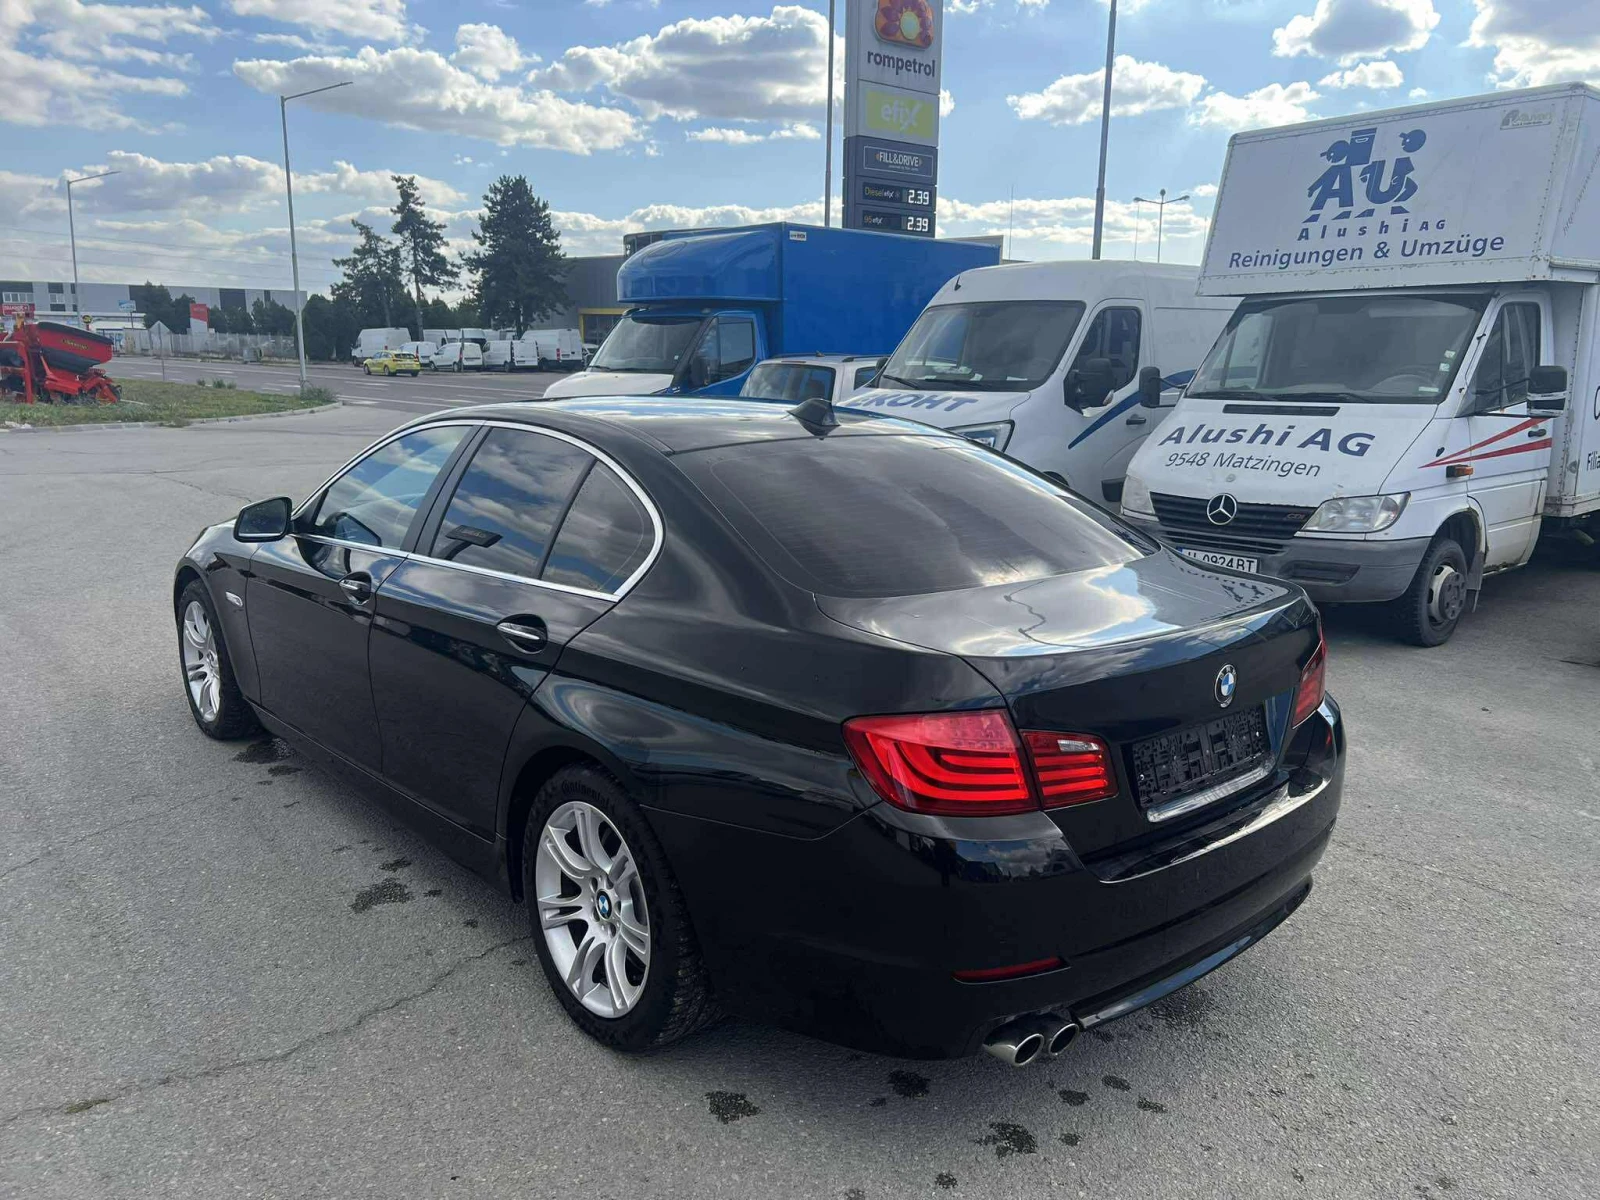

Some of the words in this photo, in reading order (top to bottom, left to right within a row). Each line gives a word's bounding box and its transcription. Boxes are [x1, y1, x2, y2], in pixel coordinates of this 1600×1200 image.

[867, 50, 936, 78] rompetrol
[879, 151, 919, 167] FILL&DRIVE
[864, 186, 884, 197] Diesel
[908, 189, 930, 205] 2.39
[863, 214, 873, 224] 95
[907, 216, 929, 232] 2.39
[1297, 219, 1409, 241] Alushi
[1419, 219, 1446, 231] AG
[1229, 247, 1363, 270] Reinigungen
[1373, 241, 1390, 259] &
[1400, 233, 1505, 257] Umzüge
[1157, 423, 1296, 446] Alushi
[1297, 428, 1376, 457] AG
[1164, 452, 1210, 467] 9548
[1212, 452, 1321, 478] Matzingen
